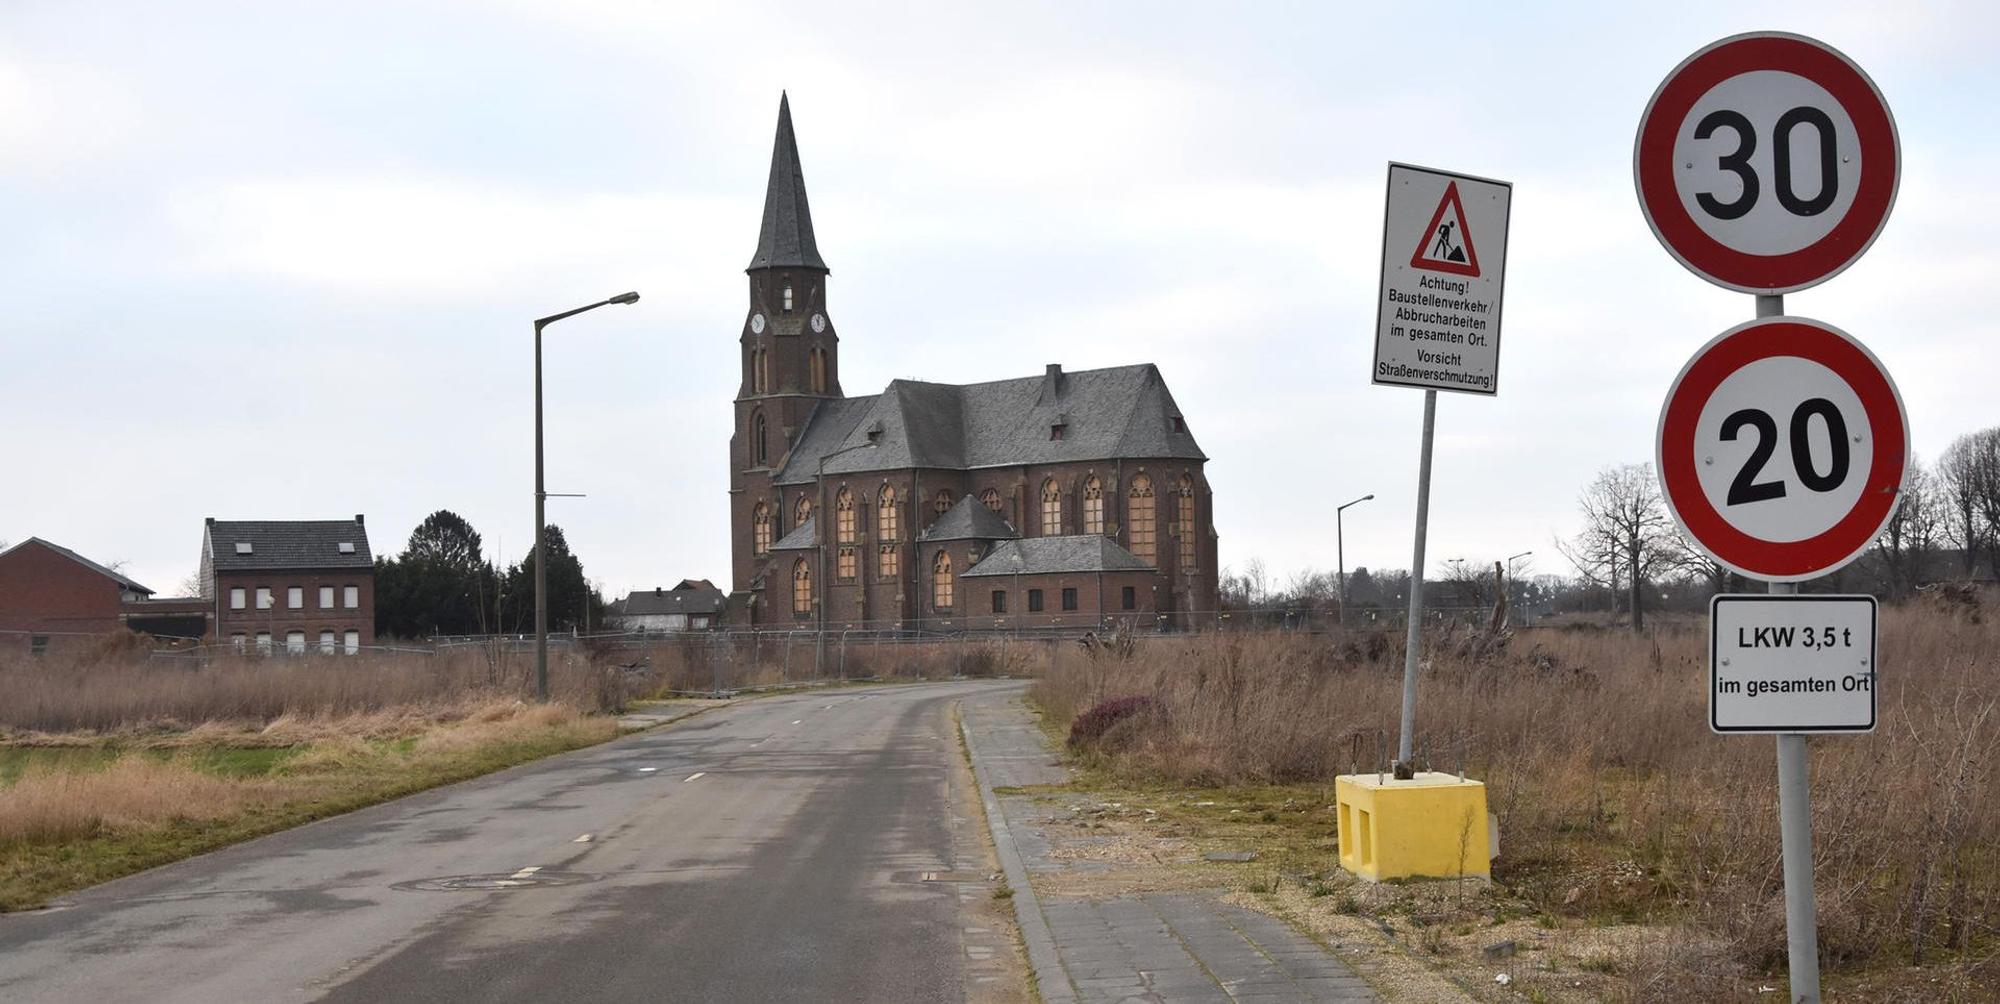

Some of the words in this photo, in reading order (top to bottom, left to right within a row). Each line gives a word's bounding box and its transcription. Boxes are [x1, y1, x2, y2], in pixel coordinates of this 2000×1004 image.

[1694, 106, 1838, 220] 30
[1420, 275, 1469, 295] Achtung!
[1396, 307, 1486, 330] Abbrucharbeiten
[1391, 323, 1404, 337] im
[1409, 328, 1463, 344] gesamten
[1468, 332, 1488, 347] Ort.
[1417, 349, 1461, 366] Vorsicht
[1379, 361, 1493, 388] Straßenverschmutzung!
[1719, 398, 1850, 506] 20
[1739, 627, 1795, 648] LKW
[1802, 627, 1836, 651] 3,5
[1843, 627, 1851, 648] t
[1719, 677, 1741, 694] im
[1747, 677, 1836, 697] gesamten
[1842, 675, 1869, 692] Ort
